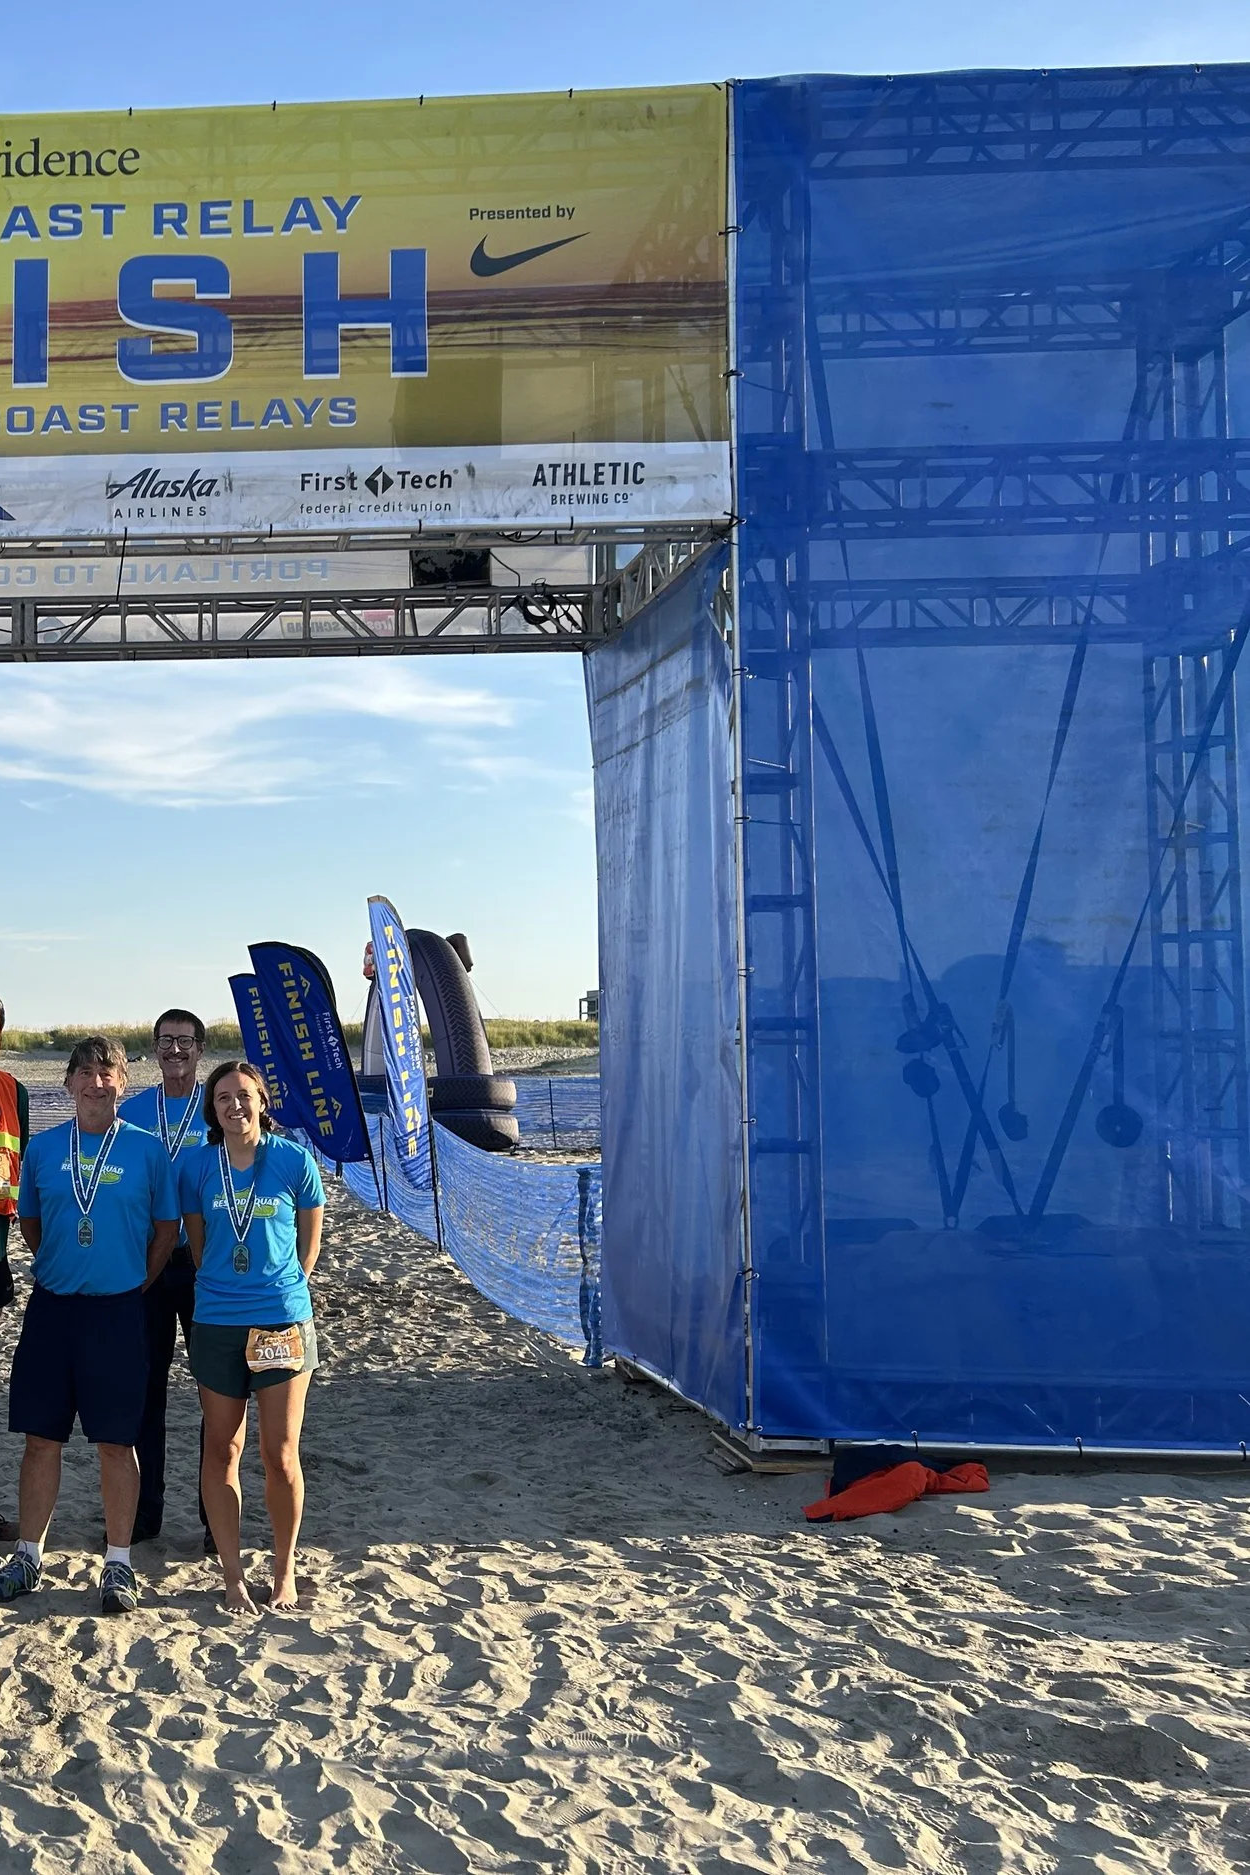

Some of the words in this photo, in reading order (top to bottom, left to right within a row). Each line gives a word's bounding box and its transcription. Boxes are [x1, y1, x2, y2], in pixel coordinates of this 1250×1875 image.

[152, 195, 362, 239] RELAY
[469, 205, 551, 220] Presented
[556, 204, 576, 220] by
[160, 397, 357, 432] RELAYS
[106, 467, 219, 501] Alaska
[300, 471, 358, 492] First
[397, 469, 453, 490] Tech
[532, 461, 645, 487] ATHLETIC
[114, 506, 207, 519] AIRLINES
[300, 503, 351, 514] federal
[358, 501, 403, 513] credit
[411, 501, 451, 512] union
[551, 493, 609, 505] BREWING
[248, 987, 272, 1057] FINISH
[265, 1063, 283, 1110] LINE
[278, 962, 315, 1061] FINISH
[306, 1070, 334, 1137] LINE
[322, 1011, 334, 1034] First
[332, 1046, 343, 1069] Tech
[384, 925, 406, 1057] FINISH
[401, 1070, 417, 1157] LINE
[255, 1343, 291, 1361] 2041
